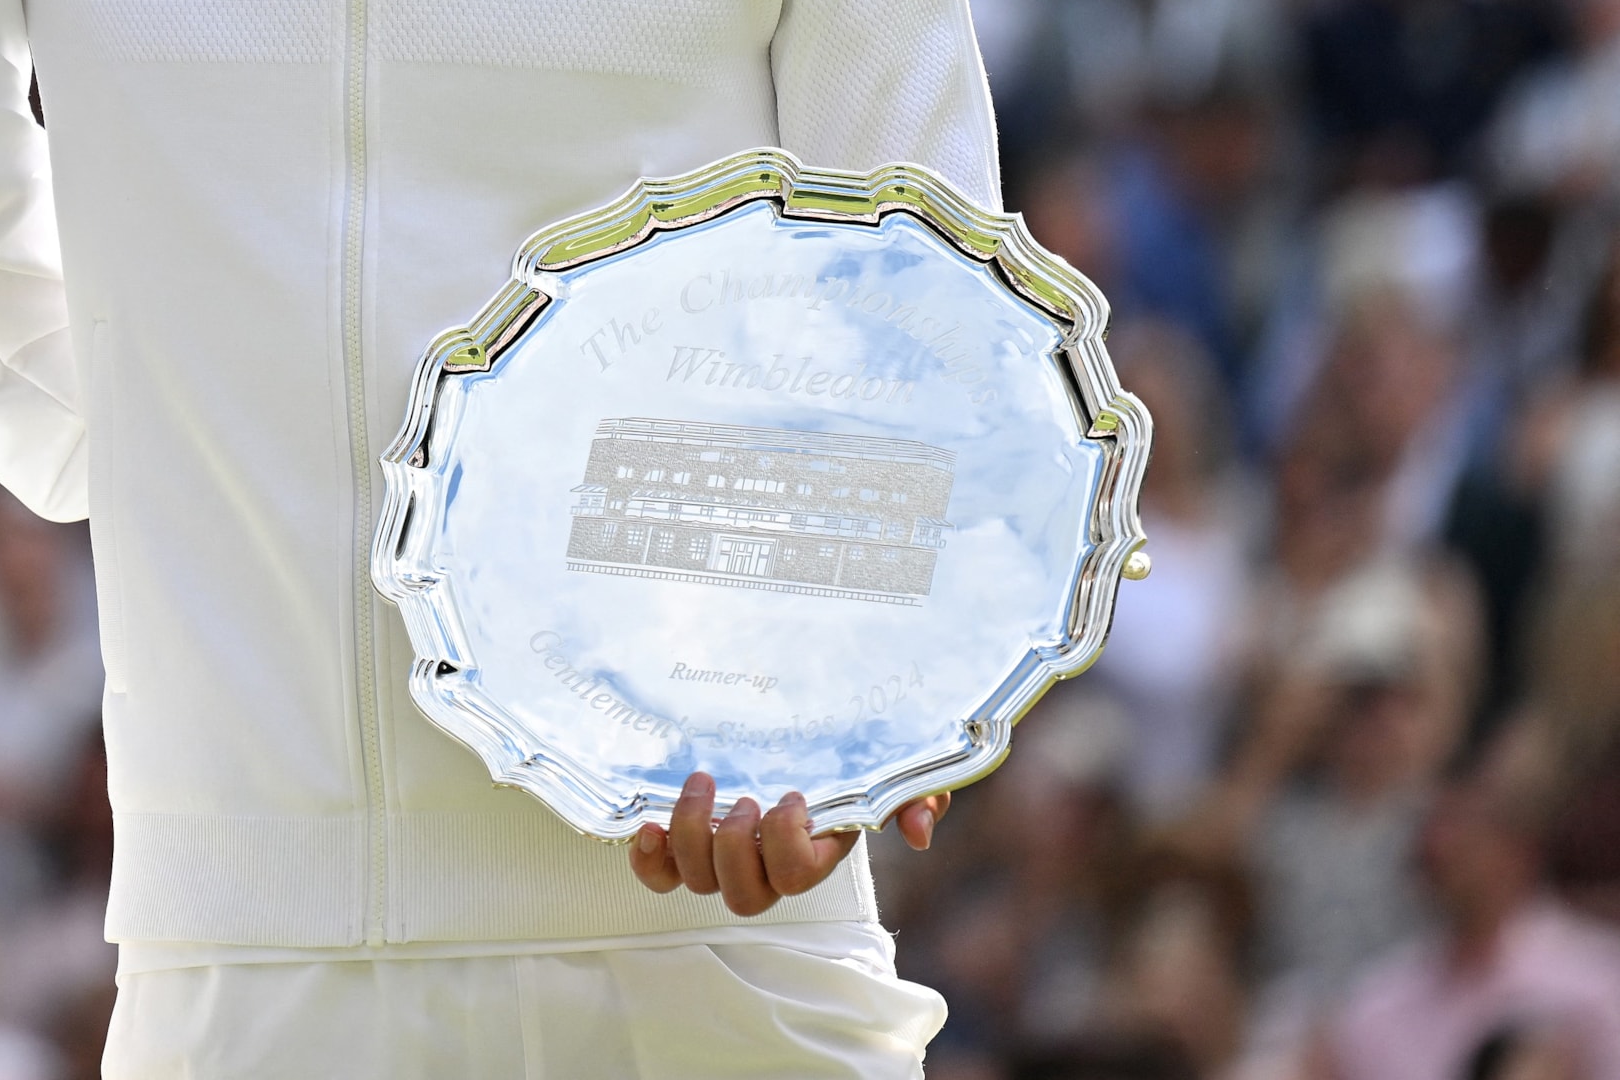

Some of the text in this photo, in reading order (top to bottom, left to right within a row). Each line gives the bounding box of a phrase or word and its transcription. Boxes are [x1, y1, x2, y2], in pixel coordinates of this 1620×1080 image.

[579, 267, 999, 406] The Championships
[665, 344, 917, 405] Wimbledon
[529, 630, 925, 754] Gentlemen's Singles 2024
[668, 661, 779, 694] Runner-up
